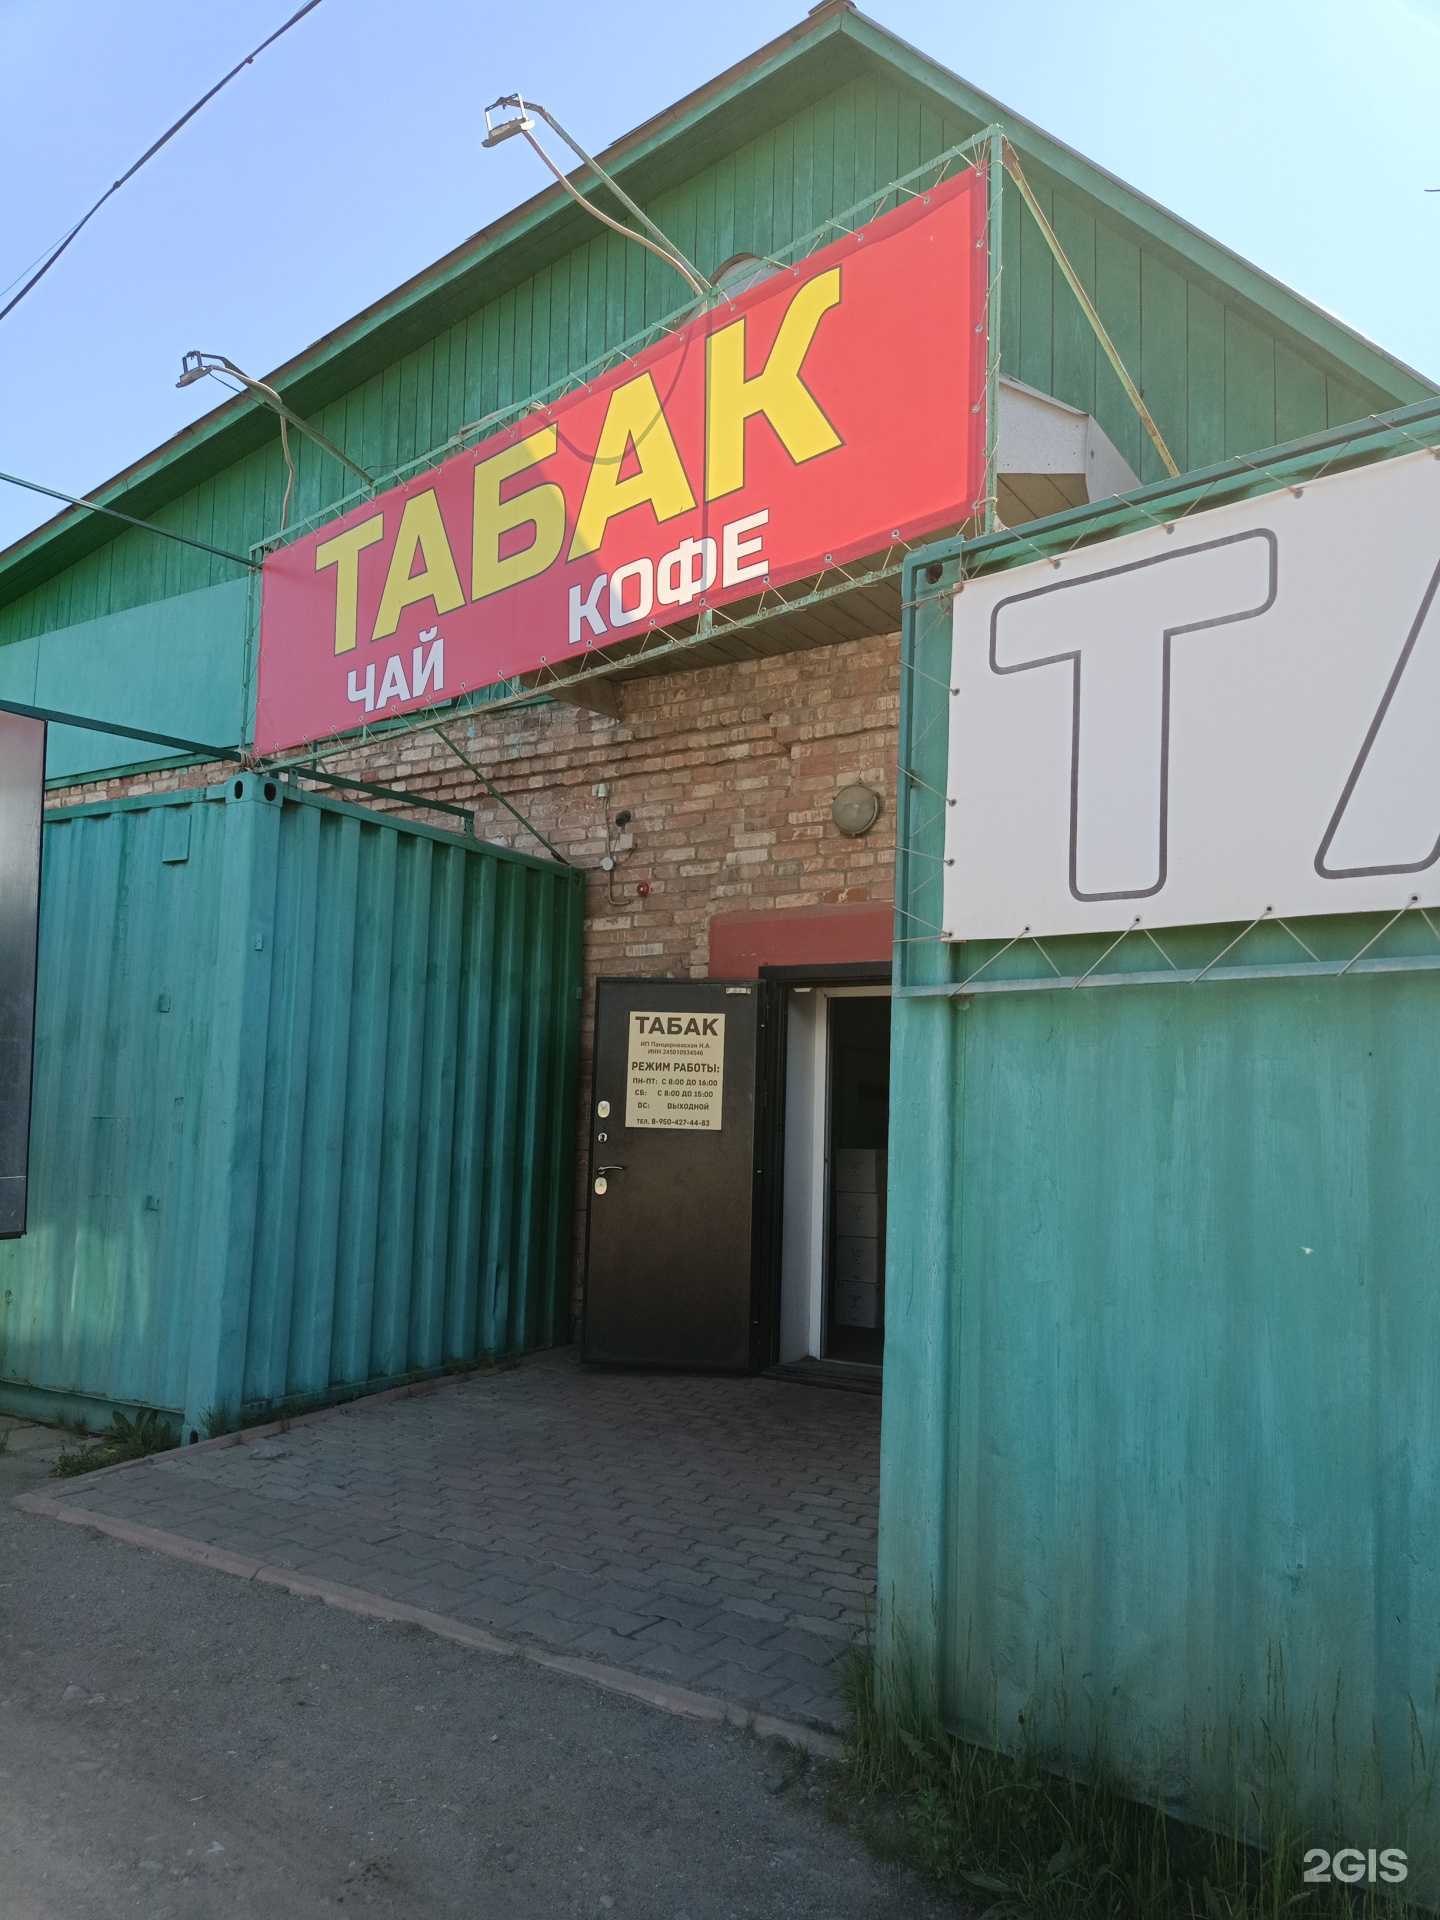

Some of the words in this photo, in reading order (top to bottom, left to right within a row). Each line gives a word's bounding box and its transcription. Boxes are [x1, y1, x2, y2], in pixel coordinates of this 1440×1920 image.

[315, 263, 844, 656] ТАБАК
[346, 626, 445, 713] ЧАЙ
[567, 508, 770, 645] КОФЕ
[634, 1016, 720, 1036] ТАБАК
[631, 1061, 671, 1072] РЕЖИМ
[673, 1062, 720, 1073] РАБОТЫ:
[632, 1077, 658, 1085] ПН-ПТ:
[667, 1102, 709, 1110] ВЫХОДНОЙ
